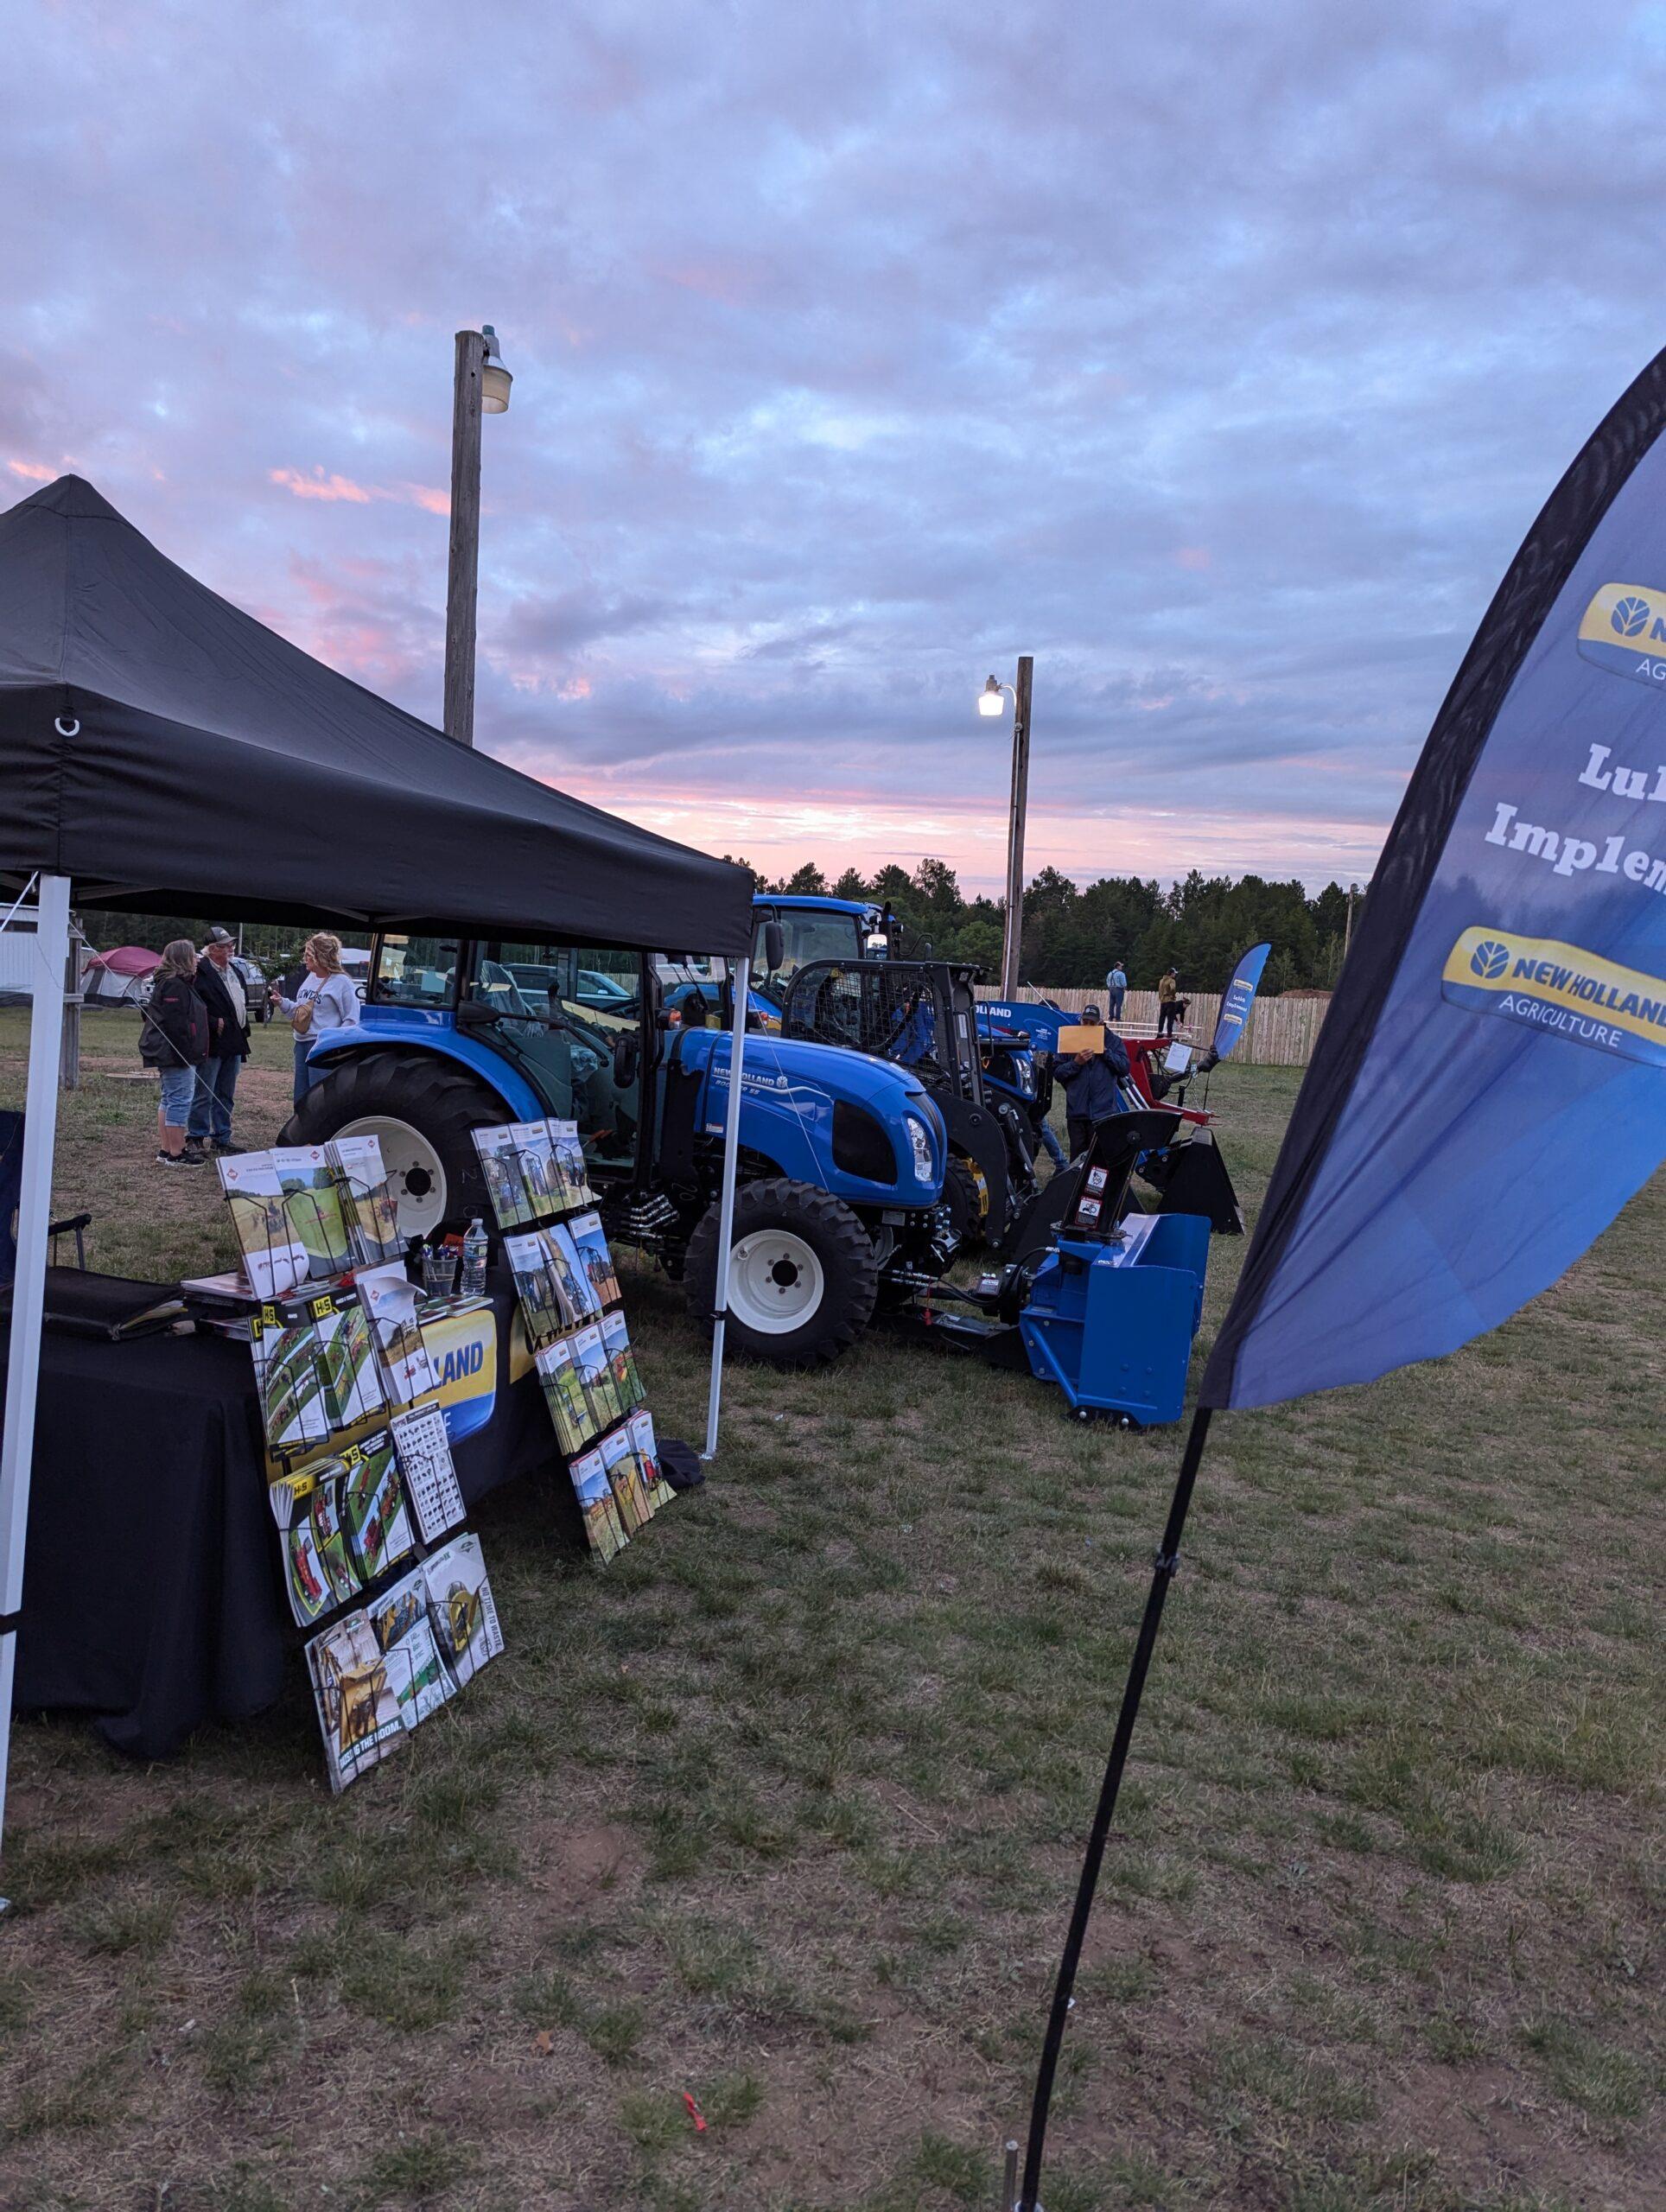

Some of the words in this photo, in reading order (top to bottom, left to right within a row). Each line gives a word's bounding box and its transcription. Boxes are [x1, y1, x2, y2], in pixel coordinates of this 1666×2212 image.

[1512, 957, 1574, 991] NEW
[1498, 995, 1623, 1048] AGRICULTURE
[741, 1072, 775, 1086] OLLAND
[483, 1599, 492, 1615] TIME
[359, 1735, 374, 1751] THE
